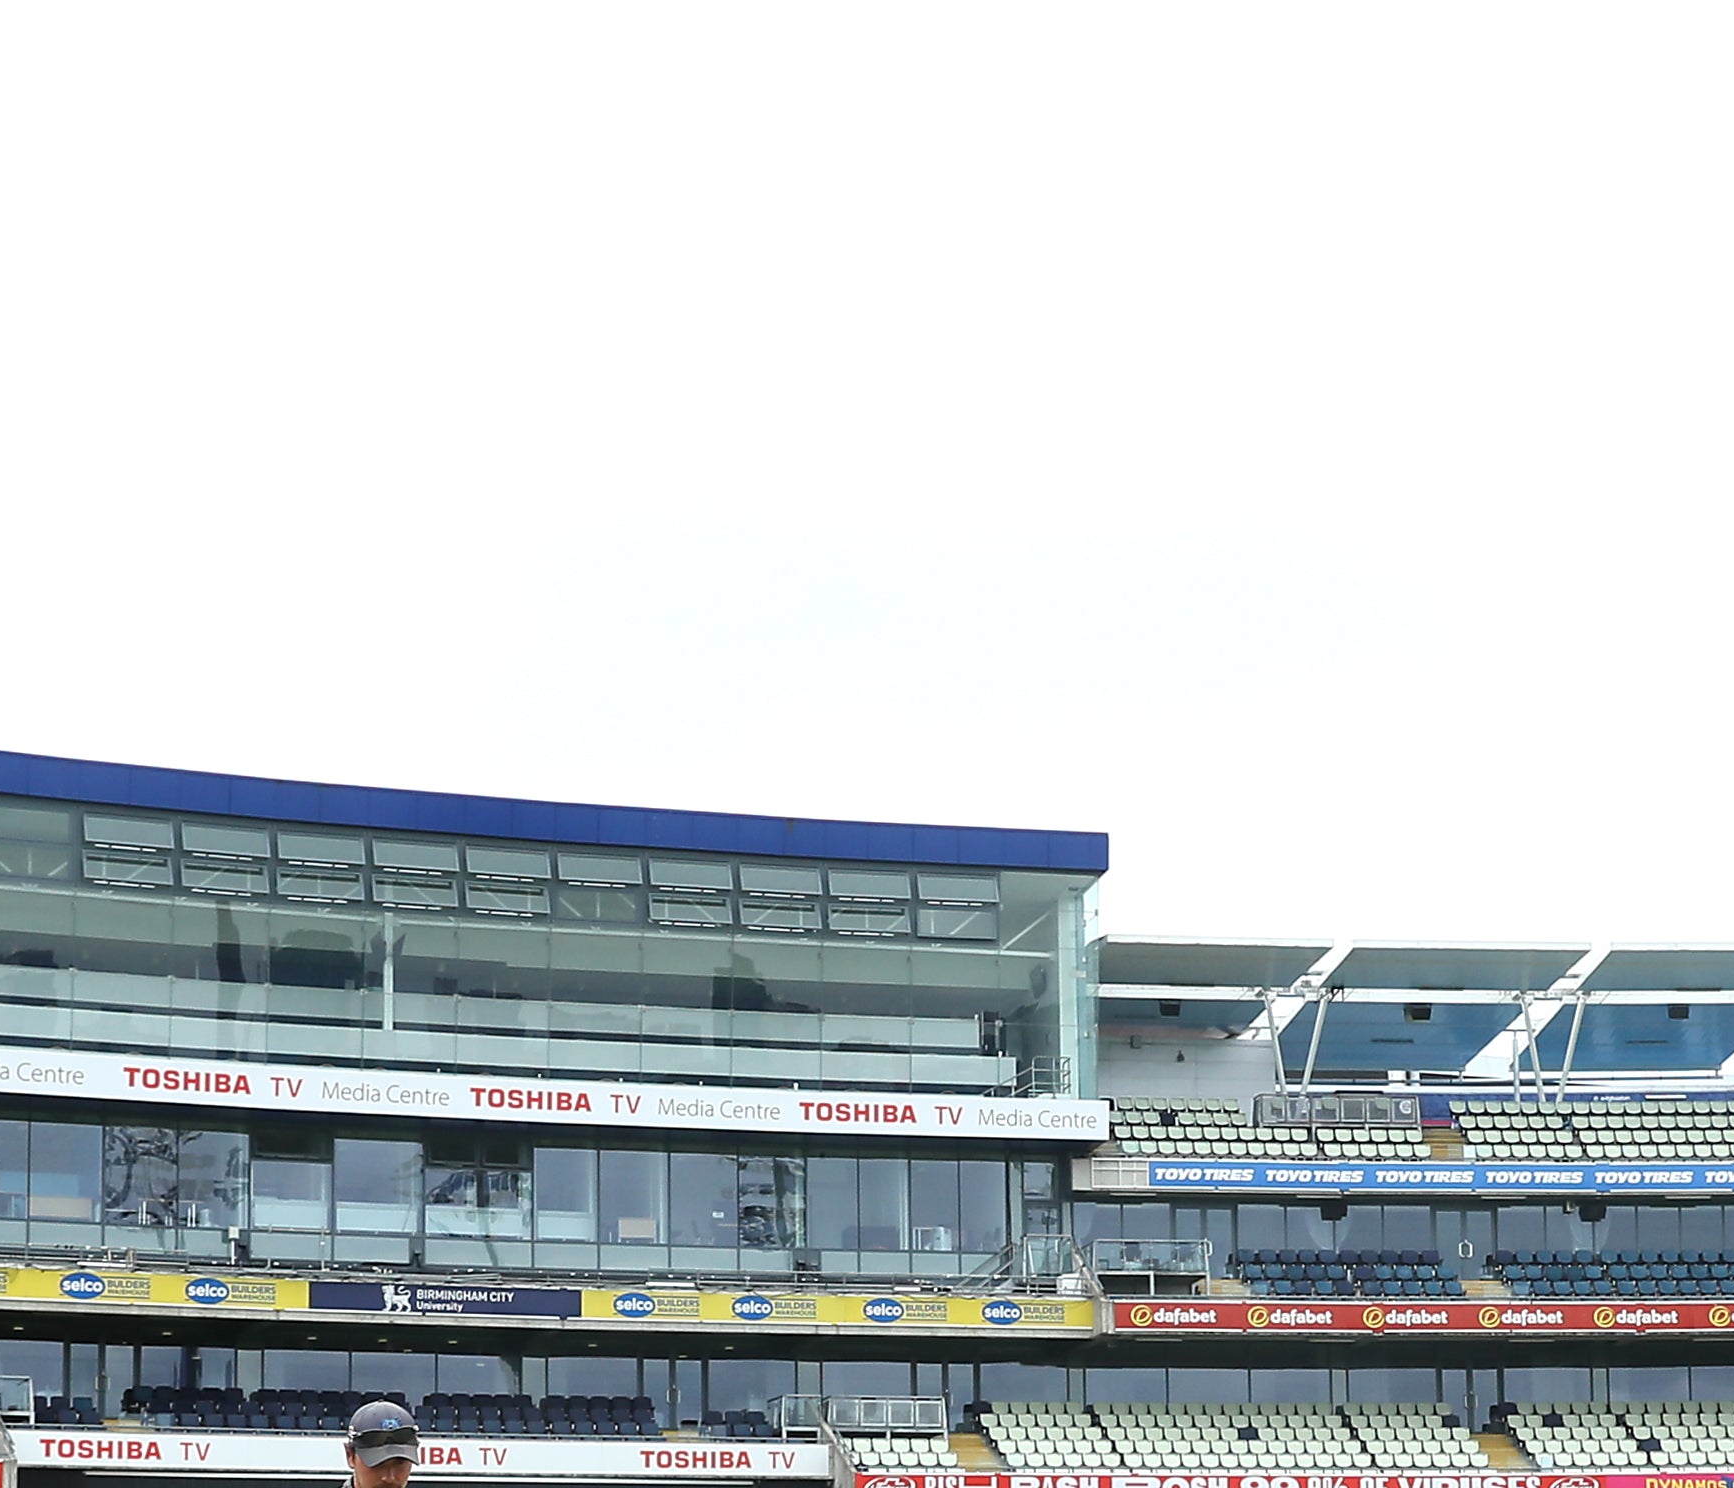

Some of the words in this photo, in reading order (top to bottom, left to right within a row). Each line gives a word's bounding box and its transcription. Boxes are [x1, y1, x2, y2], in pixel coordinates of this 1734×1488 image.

[16, 1061, 85, 1086] Centre
[123, 1066, 251, 1095] TOSHIBA
[269, 1076, 303, 1098] TV
[321, 1080, 381, 1103] Media
[385, 1084, 451, 1107] Centre
[469, 1087, 592, 1112] TOSHIBA
[609, 1094, 642, 1114] TV
[657, 1097, 715, 1118] Media
[719, 1099, 782, 1121] Centre
[798, 1101, 917, 1124] TOSHIBA
[934, 1105, 963, 1126] TV
[977, 1108, 1033, 1128] Media
[1037, 1109, 1098, 1130] Centre
[1154, 1167, 1203, 1181] TOYO
[1203, 1168, 1255, 1182] TIRES
[1265, 1169, 1313, 1183] TOYO
[1313, 1170, 1365, 1183] TIRES
[1375, 1170, 1423, 1183] TOYO
[1423, 1170, 1475, 1184] TIRES
[1485, 1171, 1533, 1184] TOYO
[1533, 1171, 1584, 1184] TIRES
[1594, 1171, 1642, 1184] TOYO
[1642, 1170, 1694, 1184] TIRES
[61, 1277, 104, 1294] selco
[187, 1283, 228, 1298] selco
[416, 1288, 488, 1302] BIRMINGHAM
[489, 1291, 515, 1303] CITY
[415, 1300, 464, 1313] University
[615, 1297, 654, 1312] selco
[733, 1300, 771, 1315] selco
[865, 1303, 903, 1318] selco
[905, 1304, 948, 1313] BUILDERS
[1023, 1306, 1065, 1315] BUILDERS
[983, 1305, 1021, 1320] selco
[1153, 1307, 1217, 1326] dafabet
[1269, 1308, 1333, 1327] dafabet
[1385, 1309, 1448, 1327] dafabet
[1500, 1308, 1564, 1327] dafabet
[1615, 1308, 1679, 1327] dafabet
[39, 1438, 162, 1460] TOSHIBA
[179, 1441, 211, 1462] TV
[478, 1447, 508, 1466] TV
[639, 1450, 752, 1469] TOSHIBA
[768, 1451, 795, 1470] TV
